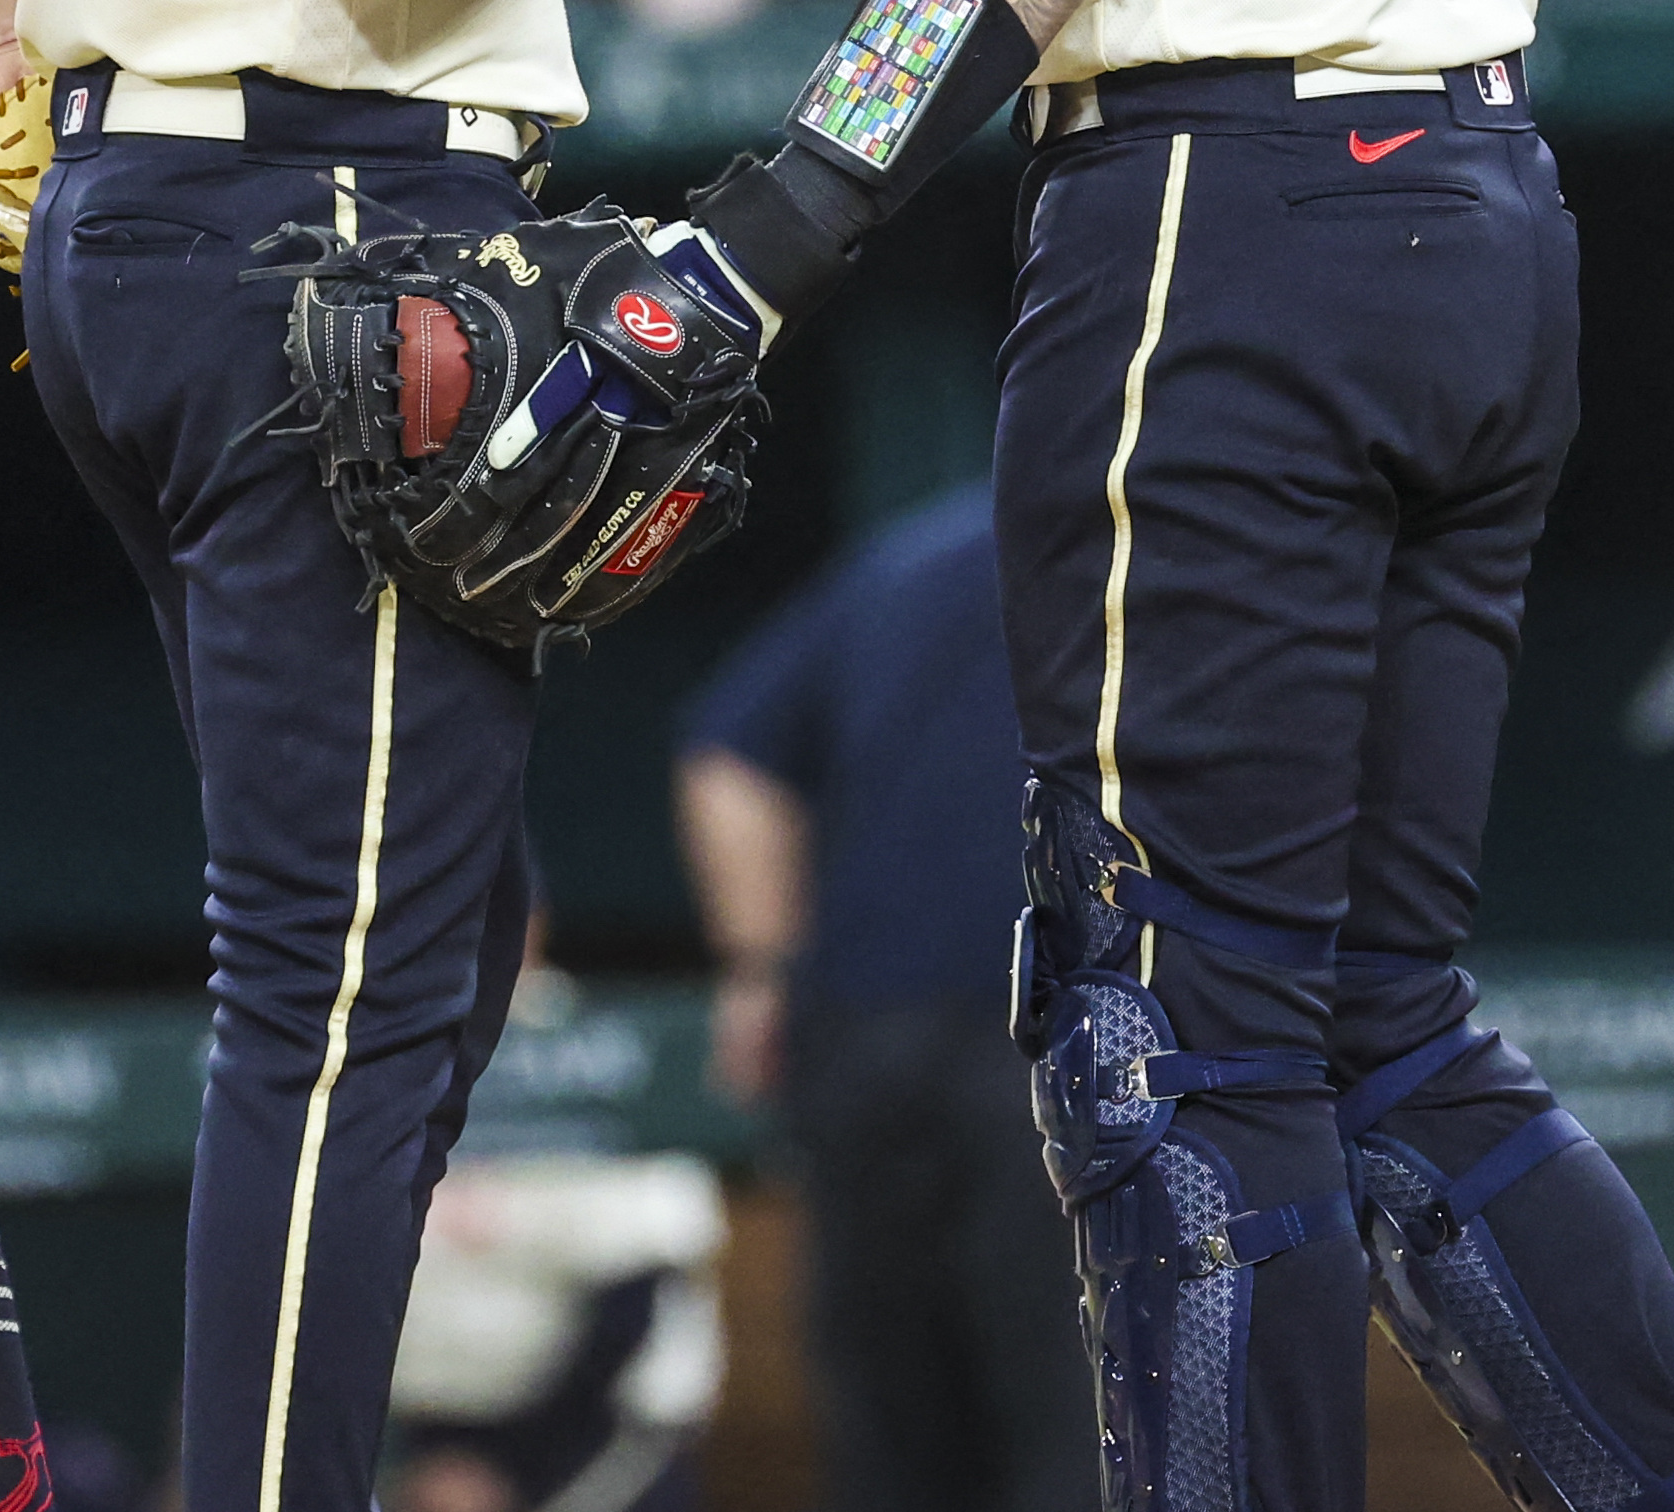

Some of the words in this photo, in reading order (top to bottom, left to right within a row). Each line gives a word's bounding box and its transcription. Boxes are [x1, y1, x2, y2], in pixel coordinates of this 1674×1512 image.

[598, 505, 633, 544] GLOVE
[625, 489, 647, 510] CO.
[626, 499, 680, 568] Rawlings
